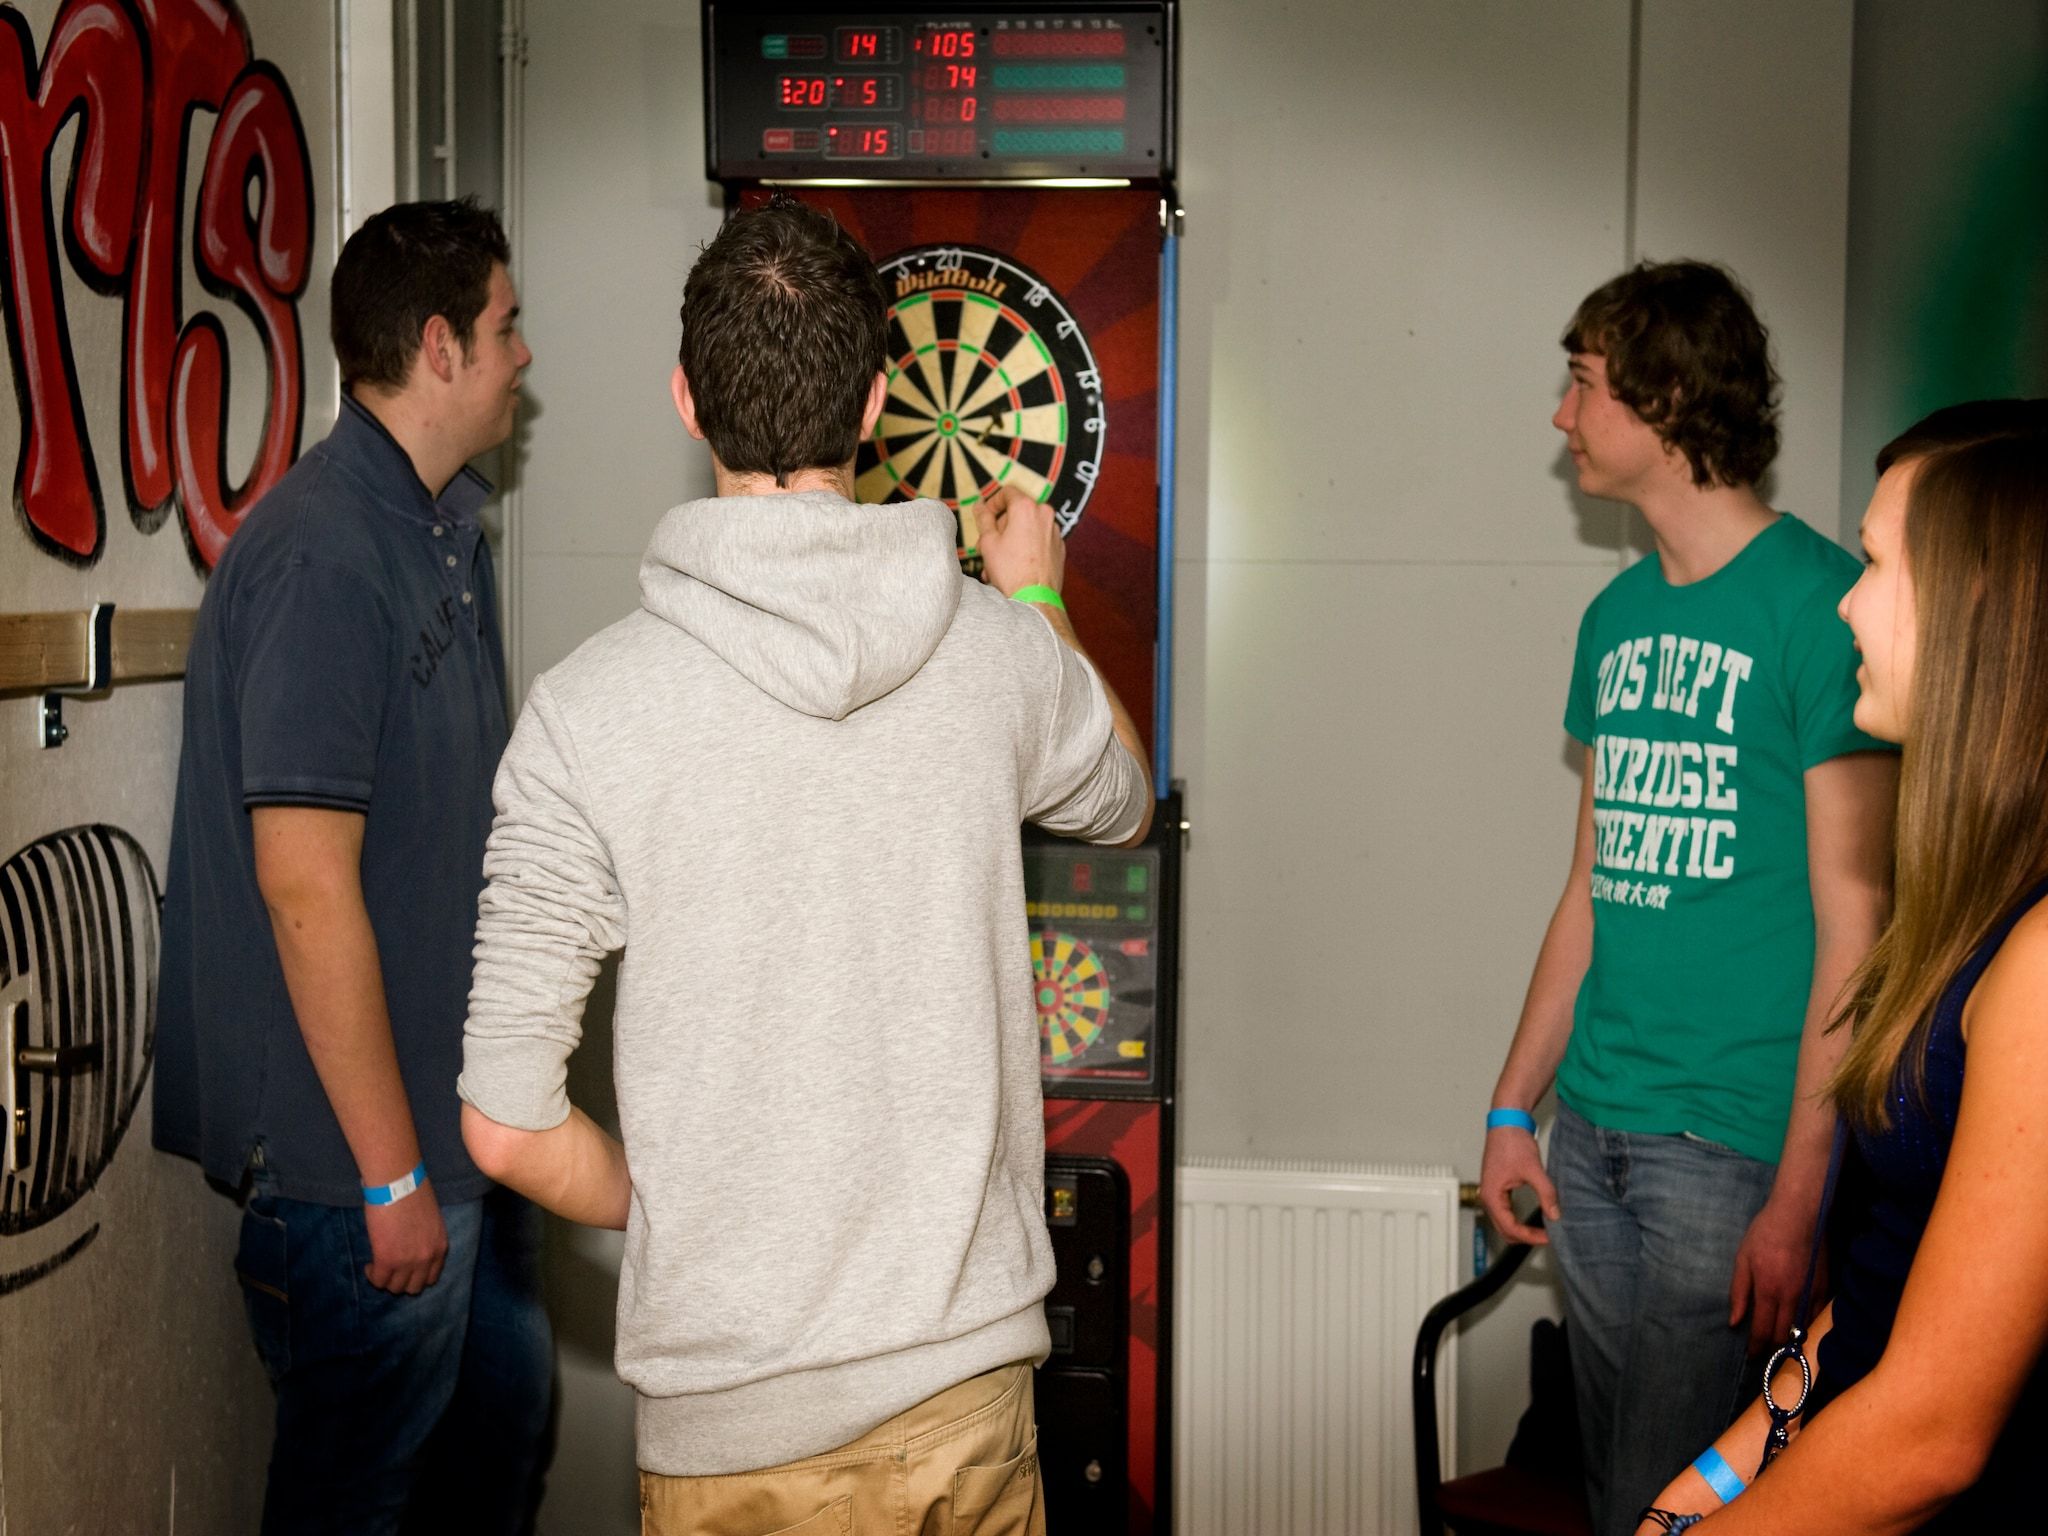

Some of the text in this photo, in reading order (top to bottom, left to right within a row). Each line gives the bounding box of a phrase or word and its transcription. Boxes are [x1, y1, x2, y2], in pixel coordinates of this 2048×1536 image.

[926, 21, 972, 30] PLAYER
[849, 33, 878, 56] 14
[931, 32, 976, 58] 105
[946, 64, 977, 89] 74
[792, 79, 825, 106] 20
[862, 79, 878, 105] 5
[960, 96, 977, 122] 0
[863, 128, 889, 155] 15
[935, 248, 963, 271] 20
[1022, 282, 1050, 308] 18
[1074, 460, 1099, 487] 10
[1652, 634, 1753, 735] DEPT
[1592, 734, 1738, 812] AYRIDGE
